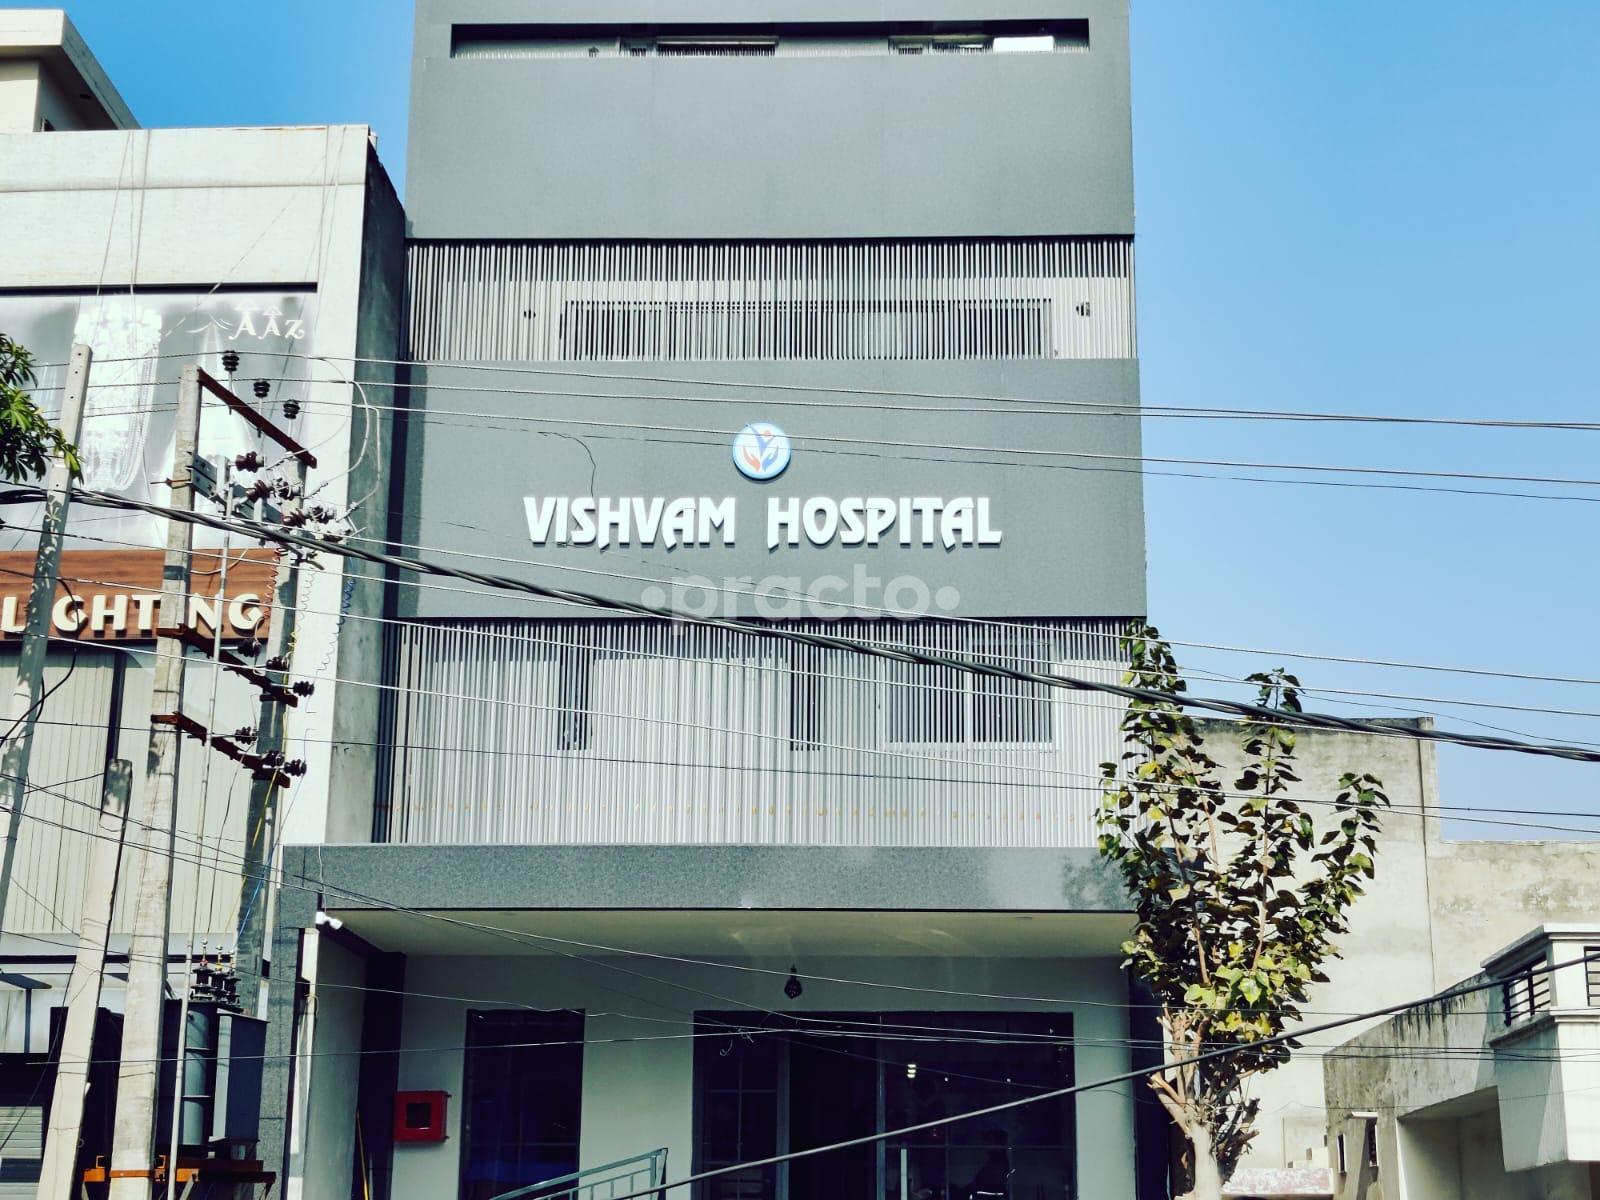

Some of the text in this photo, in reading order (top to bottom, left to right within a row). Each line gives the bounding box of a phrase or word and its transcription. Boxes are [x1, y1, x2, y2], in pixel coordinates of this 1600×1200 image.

[523, 495, 1002, 550] VISHVAM HOSPITAL
[1, 593, 263, 632] LGHTNG
